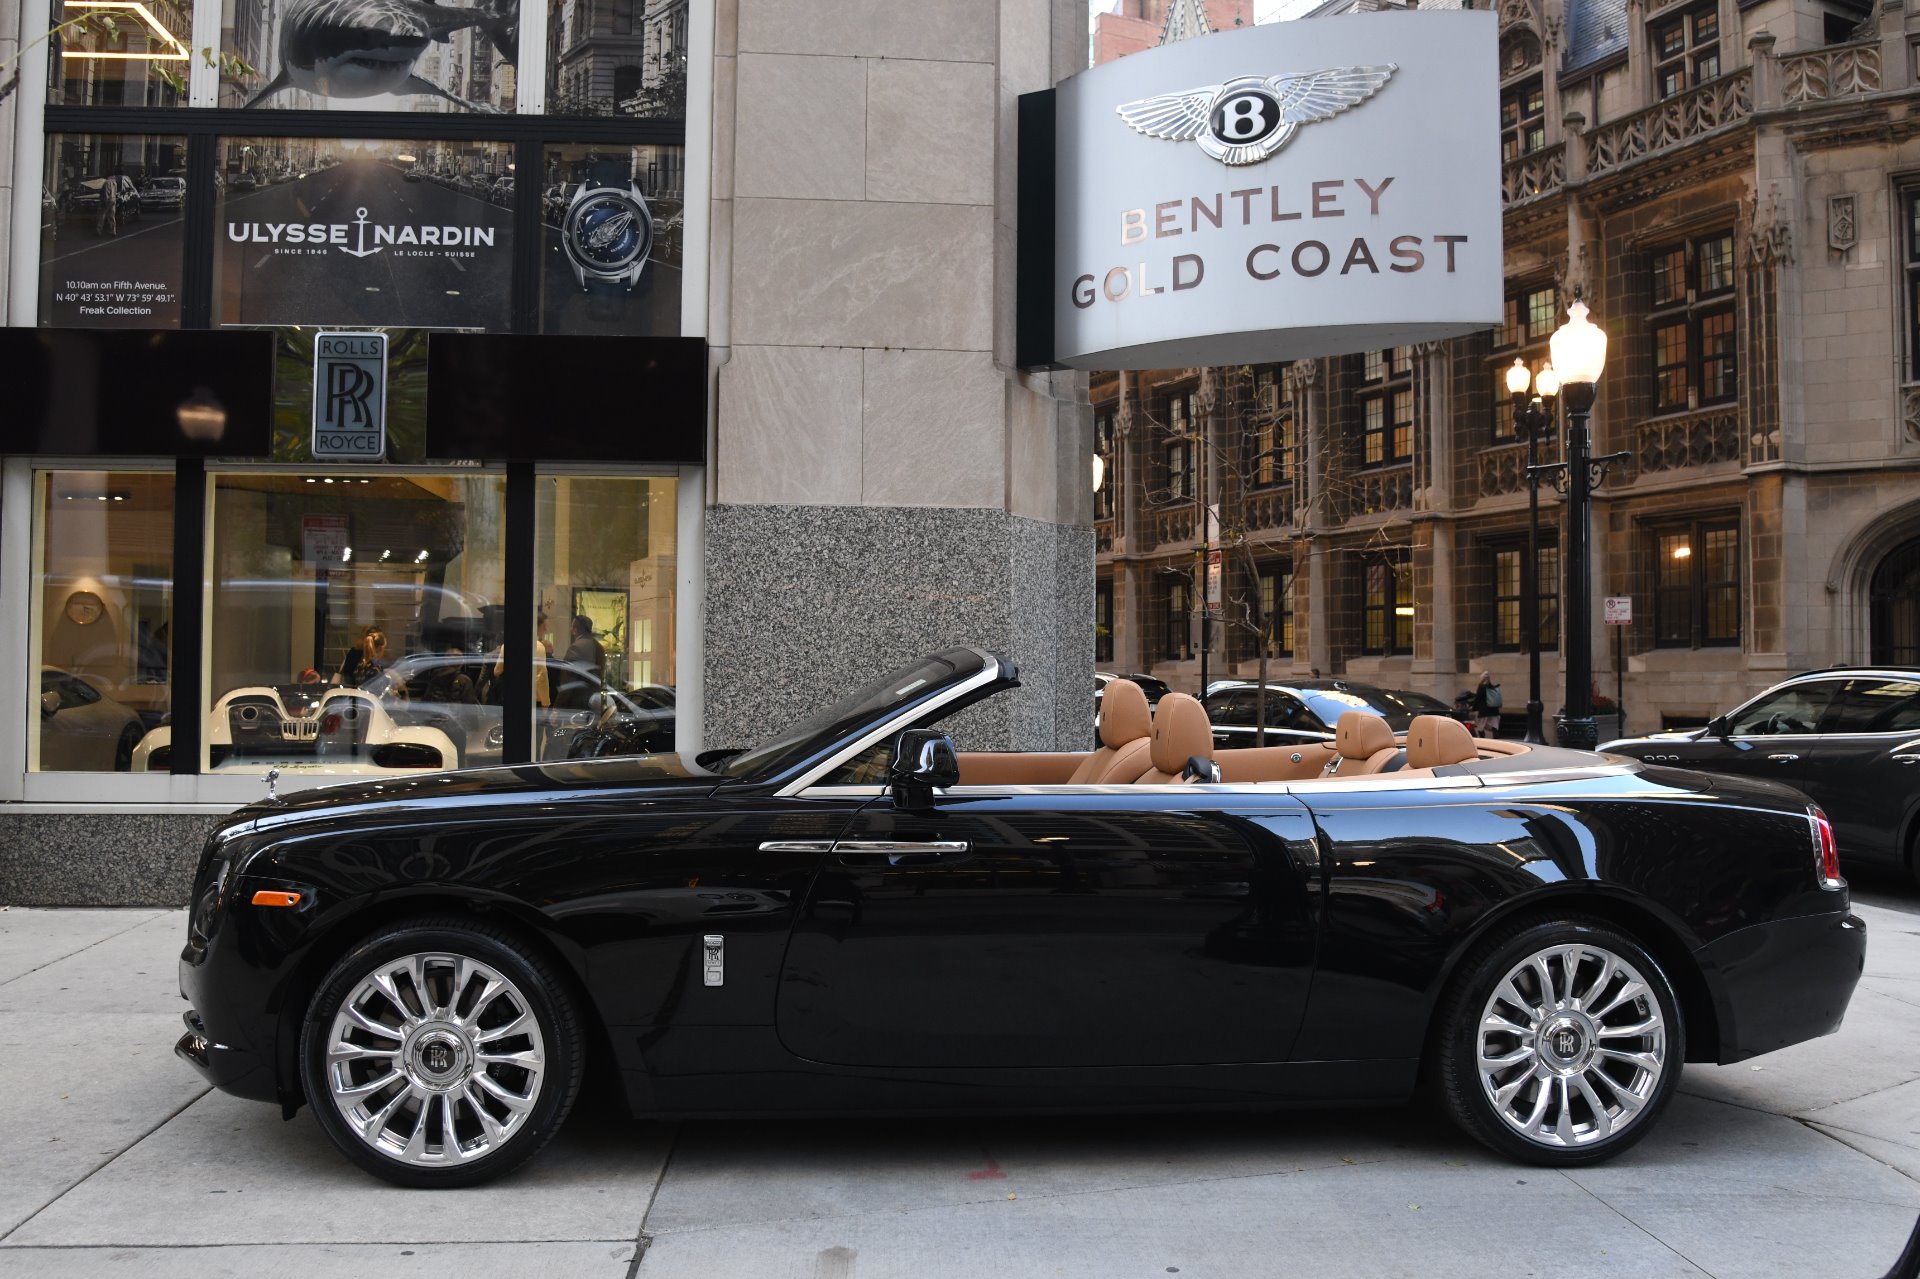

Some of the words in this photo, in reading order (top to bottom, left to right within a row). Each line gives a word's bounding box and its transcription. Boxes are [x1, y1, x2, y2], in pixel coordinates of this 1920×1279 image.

[1222, 96, 1266, 140] B
[1121, 177, 1395, 246] BENTLEY
[228, 222, 349, 244] ULYSSE
[374, 225, 495, 246] NARDIN
[1072, 253, 1205, 310] GOLD
[1246, 235, 1468, 281] COAST
[66, 280, 99, 289] 10.10am
[113, 280, 133, 290] Fifth
[134, 281, 168, 290] Avenue.
[56, 293, 63, 301] N
[115, 294, 126, 302] W
[79, 306, 105, 315] Freak
[106, 306, 152, 315] Collection
[322, 340, 379, 355] ROLLS
[325, 362, 375, 428] RR
[319, 435, 376, 450] ROYCE
